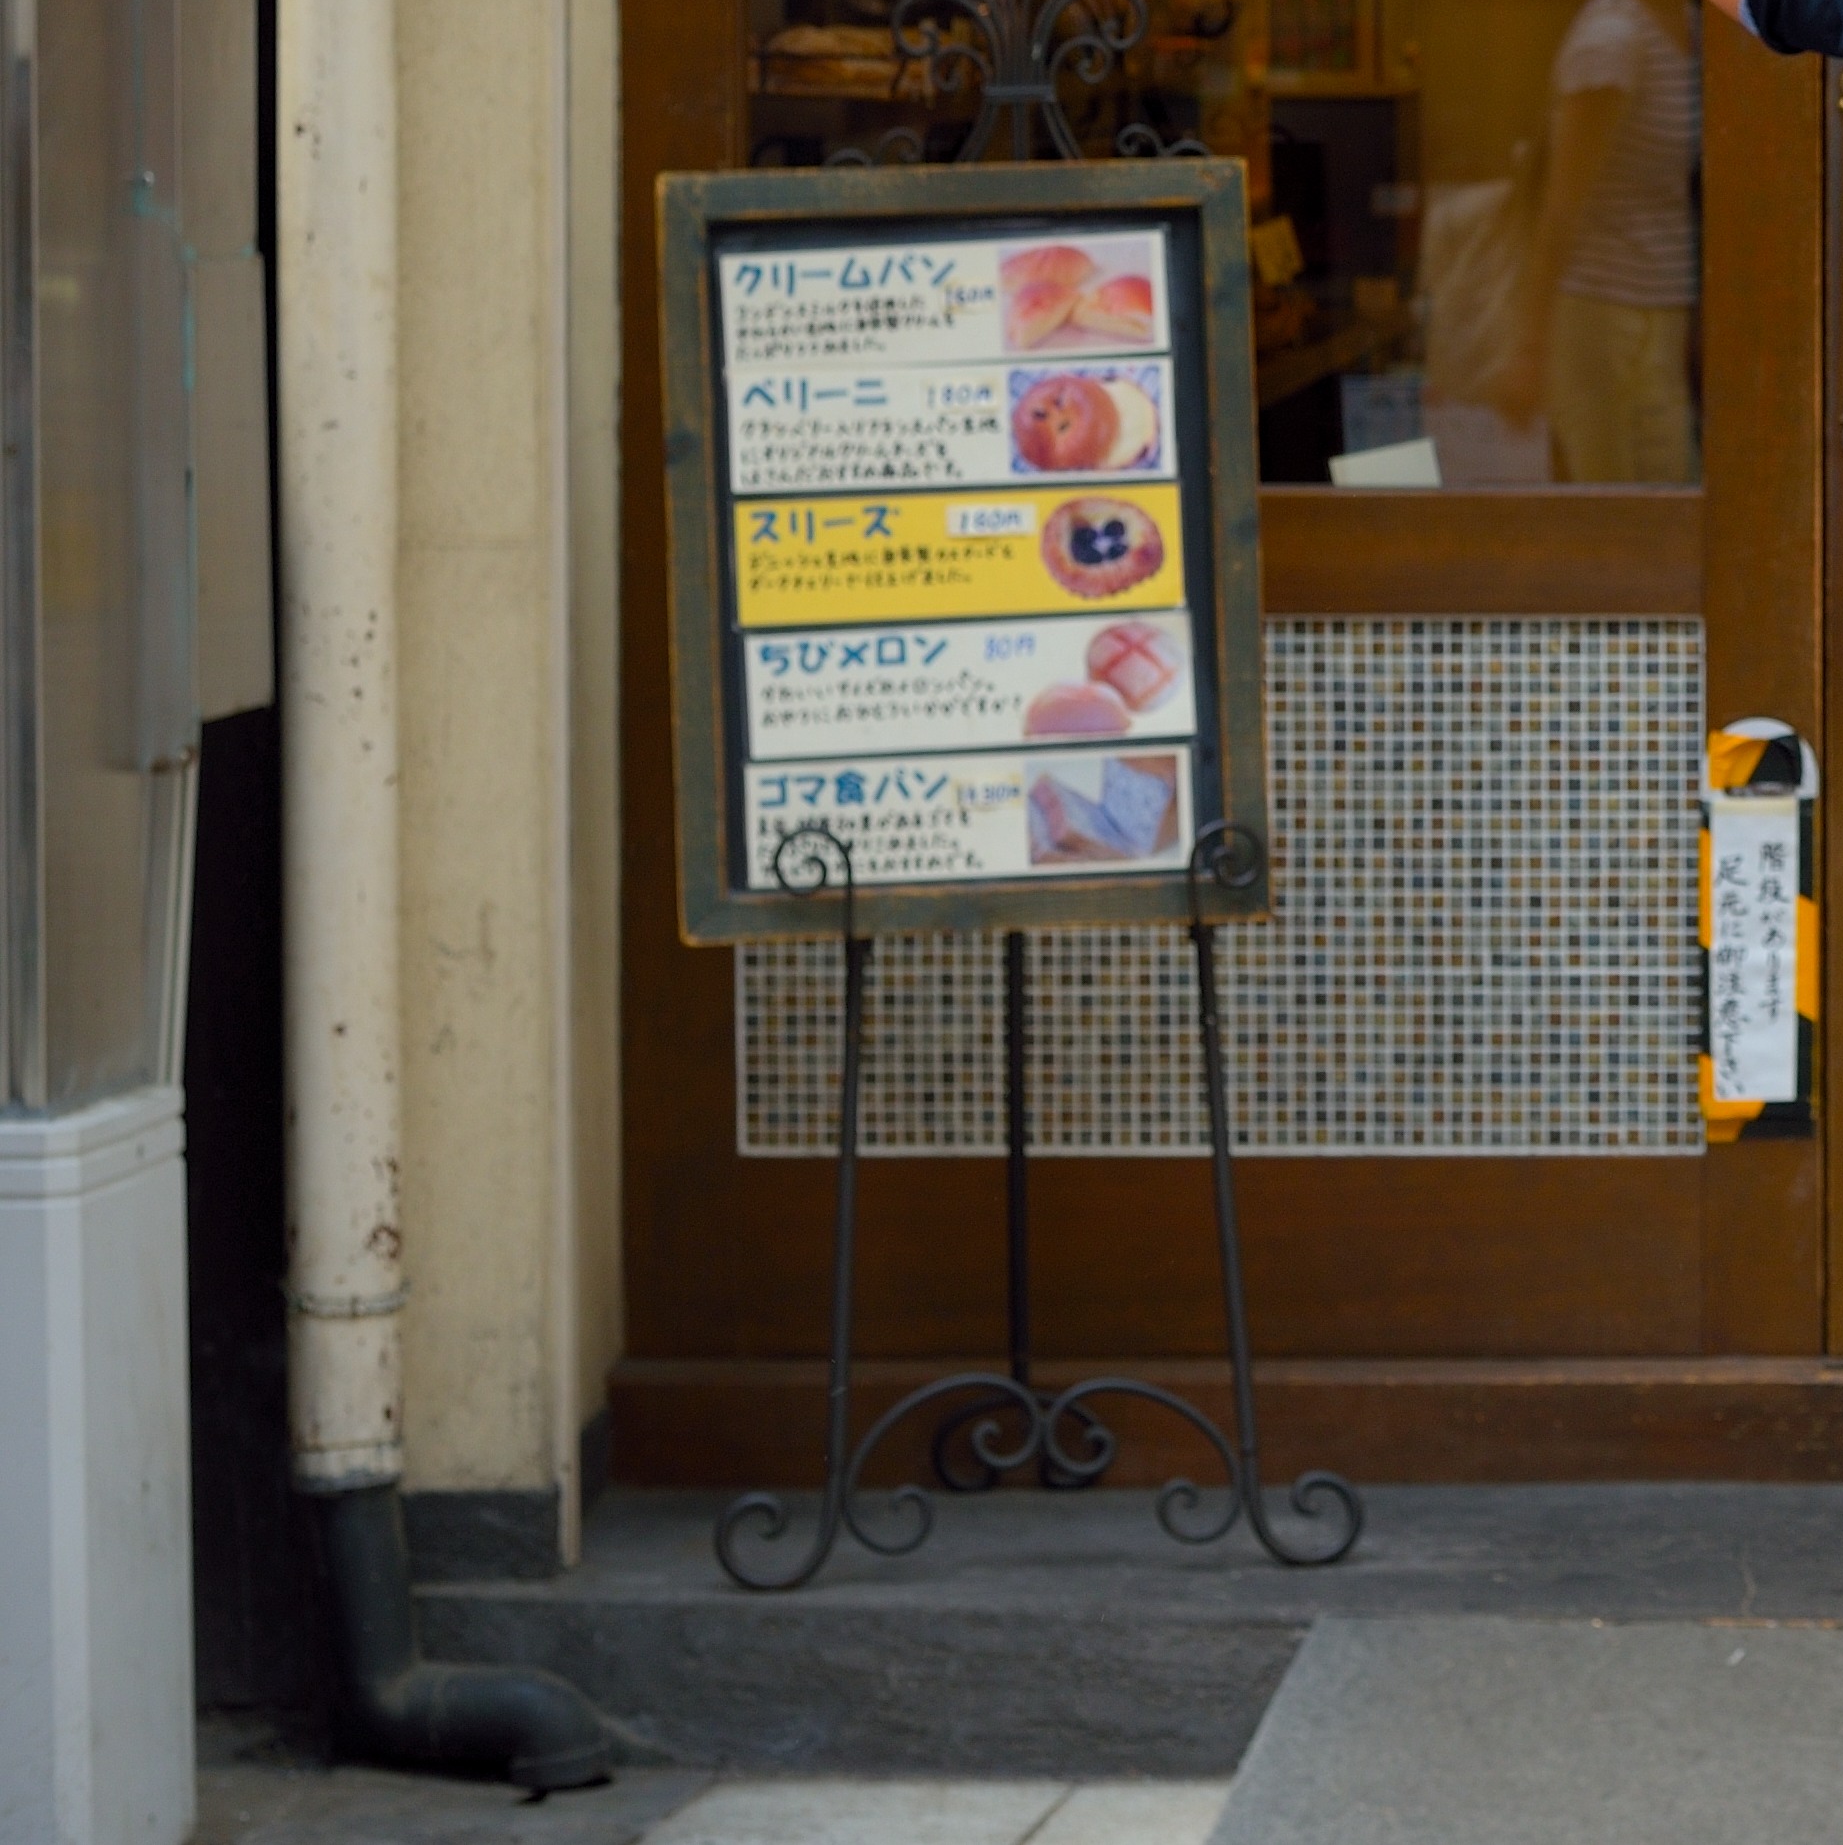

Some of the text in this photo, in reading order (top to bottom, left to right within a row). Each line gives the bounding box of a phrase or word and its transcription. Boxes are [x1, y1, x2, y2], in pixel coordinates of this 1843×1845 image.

[735, 256, 956, 297] クリームパン
[743, 378, 888, 412] ベリーニ
[750, 505, 901, 544] スリーズ
[760, 635, 949, 676] ちびメロン
[759, 766, 949, 809] ゴマ食パン
